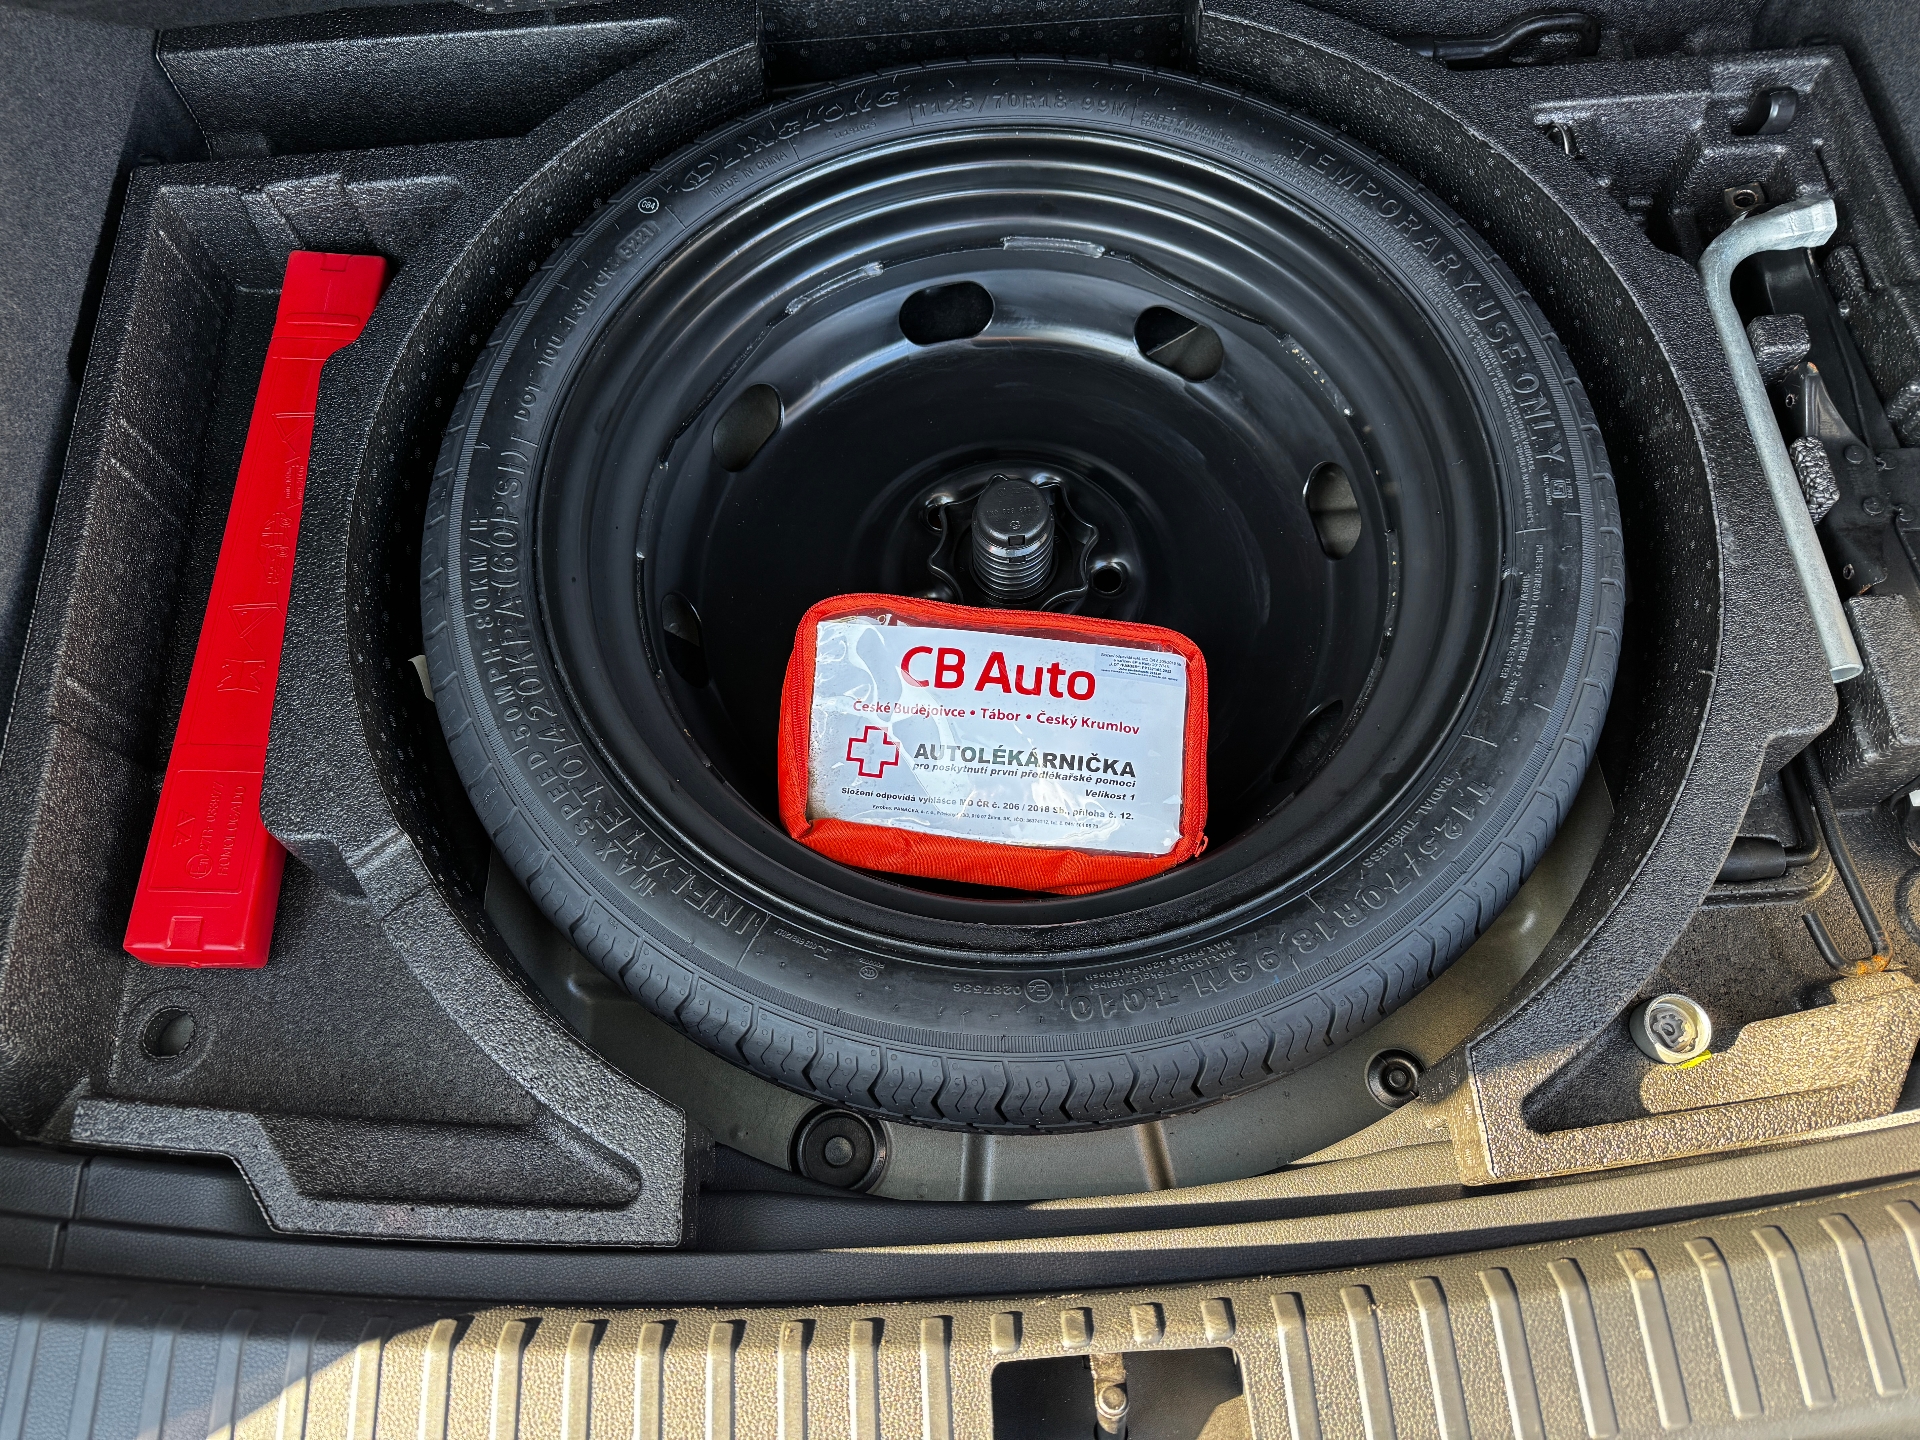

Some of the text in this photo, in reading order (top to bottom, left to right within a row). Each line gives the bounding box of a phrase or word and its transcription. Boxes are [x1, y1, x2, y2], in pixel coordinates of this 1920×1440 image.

[1080, 95, 1129, 118] 99M
[705, 149, 790, 199] MADE IN CHINA
[1285, 137, 1483, 294] TEMPORARY
[1464, 297, 1531, 365] USE
[1505, 371, 1567, 464] ONLY
[513, 380, 542, 422] DOT
[900, 645, 966, 689] CB
[974, 650, 1096, 701] Auto
[853, 699, 891, 714] České
[980, 708, 1021, 722] Tábor
[1036, 710, 1078, 729] Český
[1081, 716, 1140, 735] Krumlov
[552, 747, 605, 808] TO
[912, 763, 930, 772] pro
[931, 764, 988, 776] poskytnutí
[989, 767, 1019, 778] první
[1094, 777, 1137, 788] pomoci
[914, 743, 1137, 778] AUTOLÉKÁRNIČKA
[522, 745, 597, 840] SPEED
[841, 787, 874, 798] Složení
[875, 791, 916, 802] odpovídá
[976, 798, 990, 808] ČR
[1002, 802, 1020, 811] 206
[1027, 804, 1050, 813] 2018
[1072, 807, 1106, 818] příloha
[1119, 812, 1135, 821] 12.
[1085, 789, 1136, 801] Velikost 1
[1412, 772, 1455, 821] RADIAL
[217, 785, 247, 877] HOMOLOGADO
[593, 837, 656, 898] MAX
[593, 799, 758, 938] INFLATE
[1287, 772, 1496, 959] T125/70R18
[1188, 942, 1284, 1000] 99M
